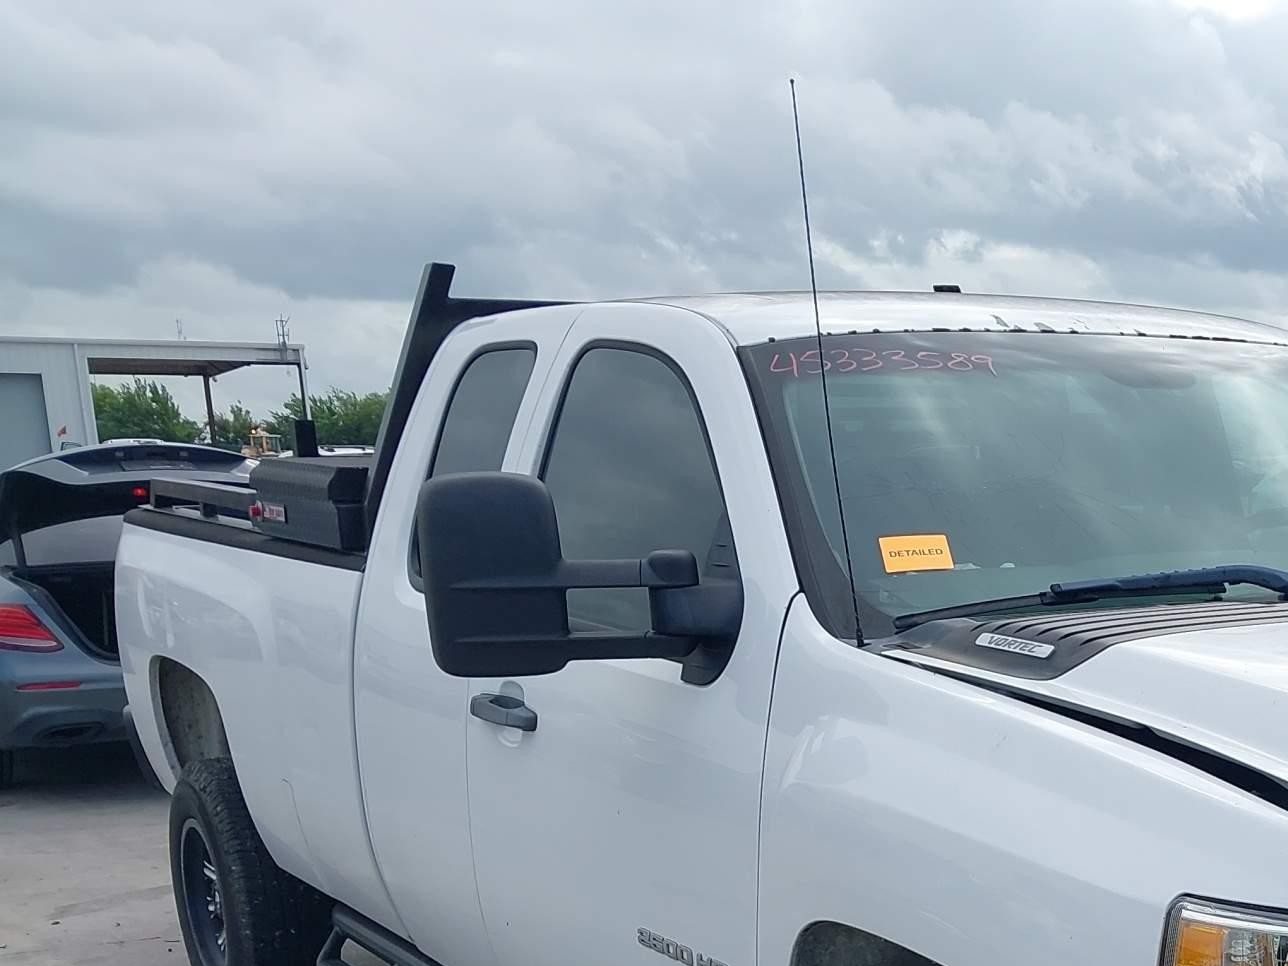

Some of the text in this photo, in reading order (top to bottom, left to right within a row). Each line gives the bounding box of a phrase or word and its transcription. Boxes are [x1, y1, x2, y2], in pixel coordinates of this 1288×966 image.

[769, 348, 998, 377] 45333589
[888, 548, 944, 558] DETAILED
[987, 635, 1044, 653] VORTEC
